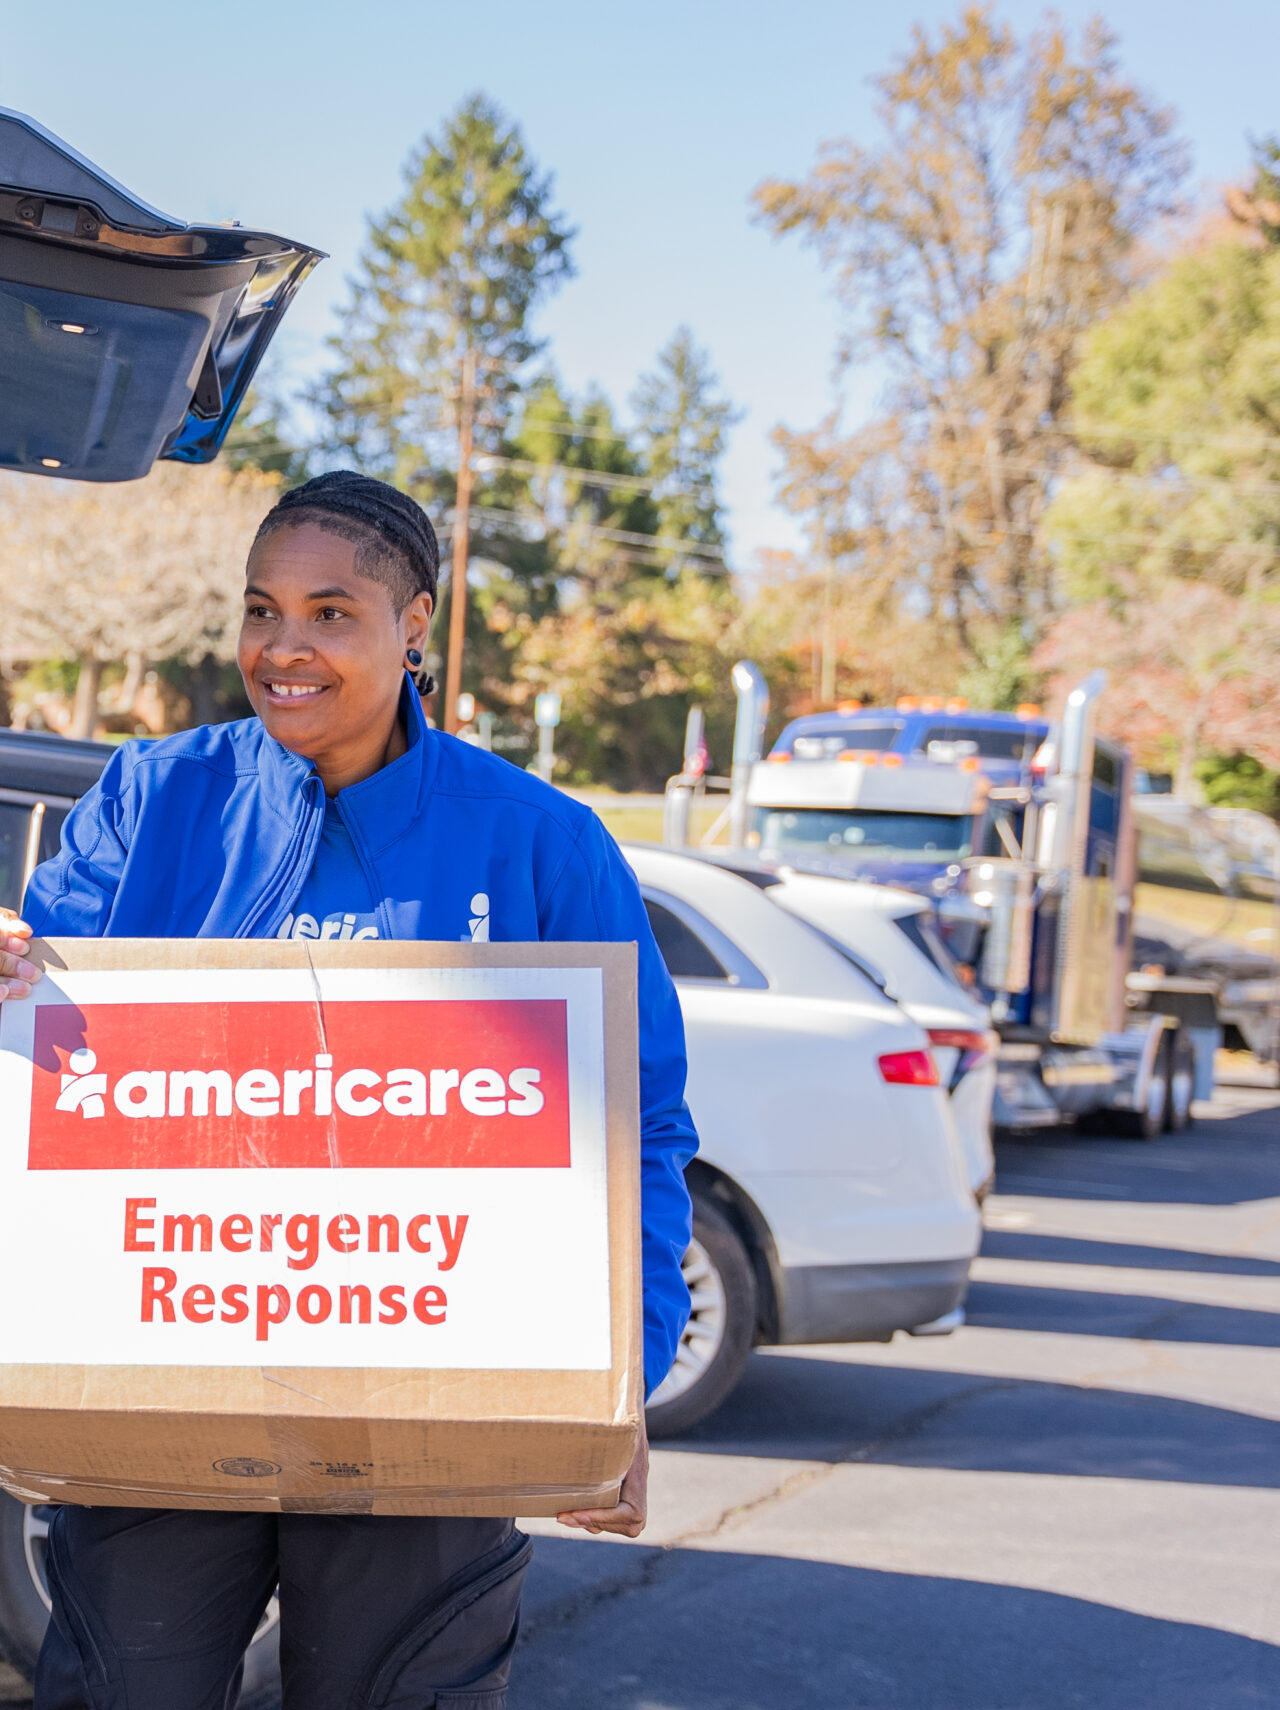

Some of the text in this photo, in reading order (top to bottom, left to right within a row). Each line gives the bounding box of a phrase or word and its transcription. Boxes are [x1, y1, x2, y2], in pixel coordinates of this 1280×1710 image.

[114, 1053, 544, 1119] americares
[124, 1197, 469, 1271] Emergency
[141, 1267, 448, 1341] Response
